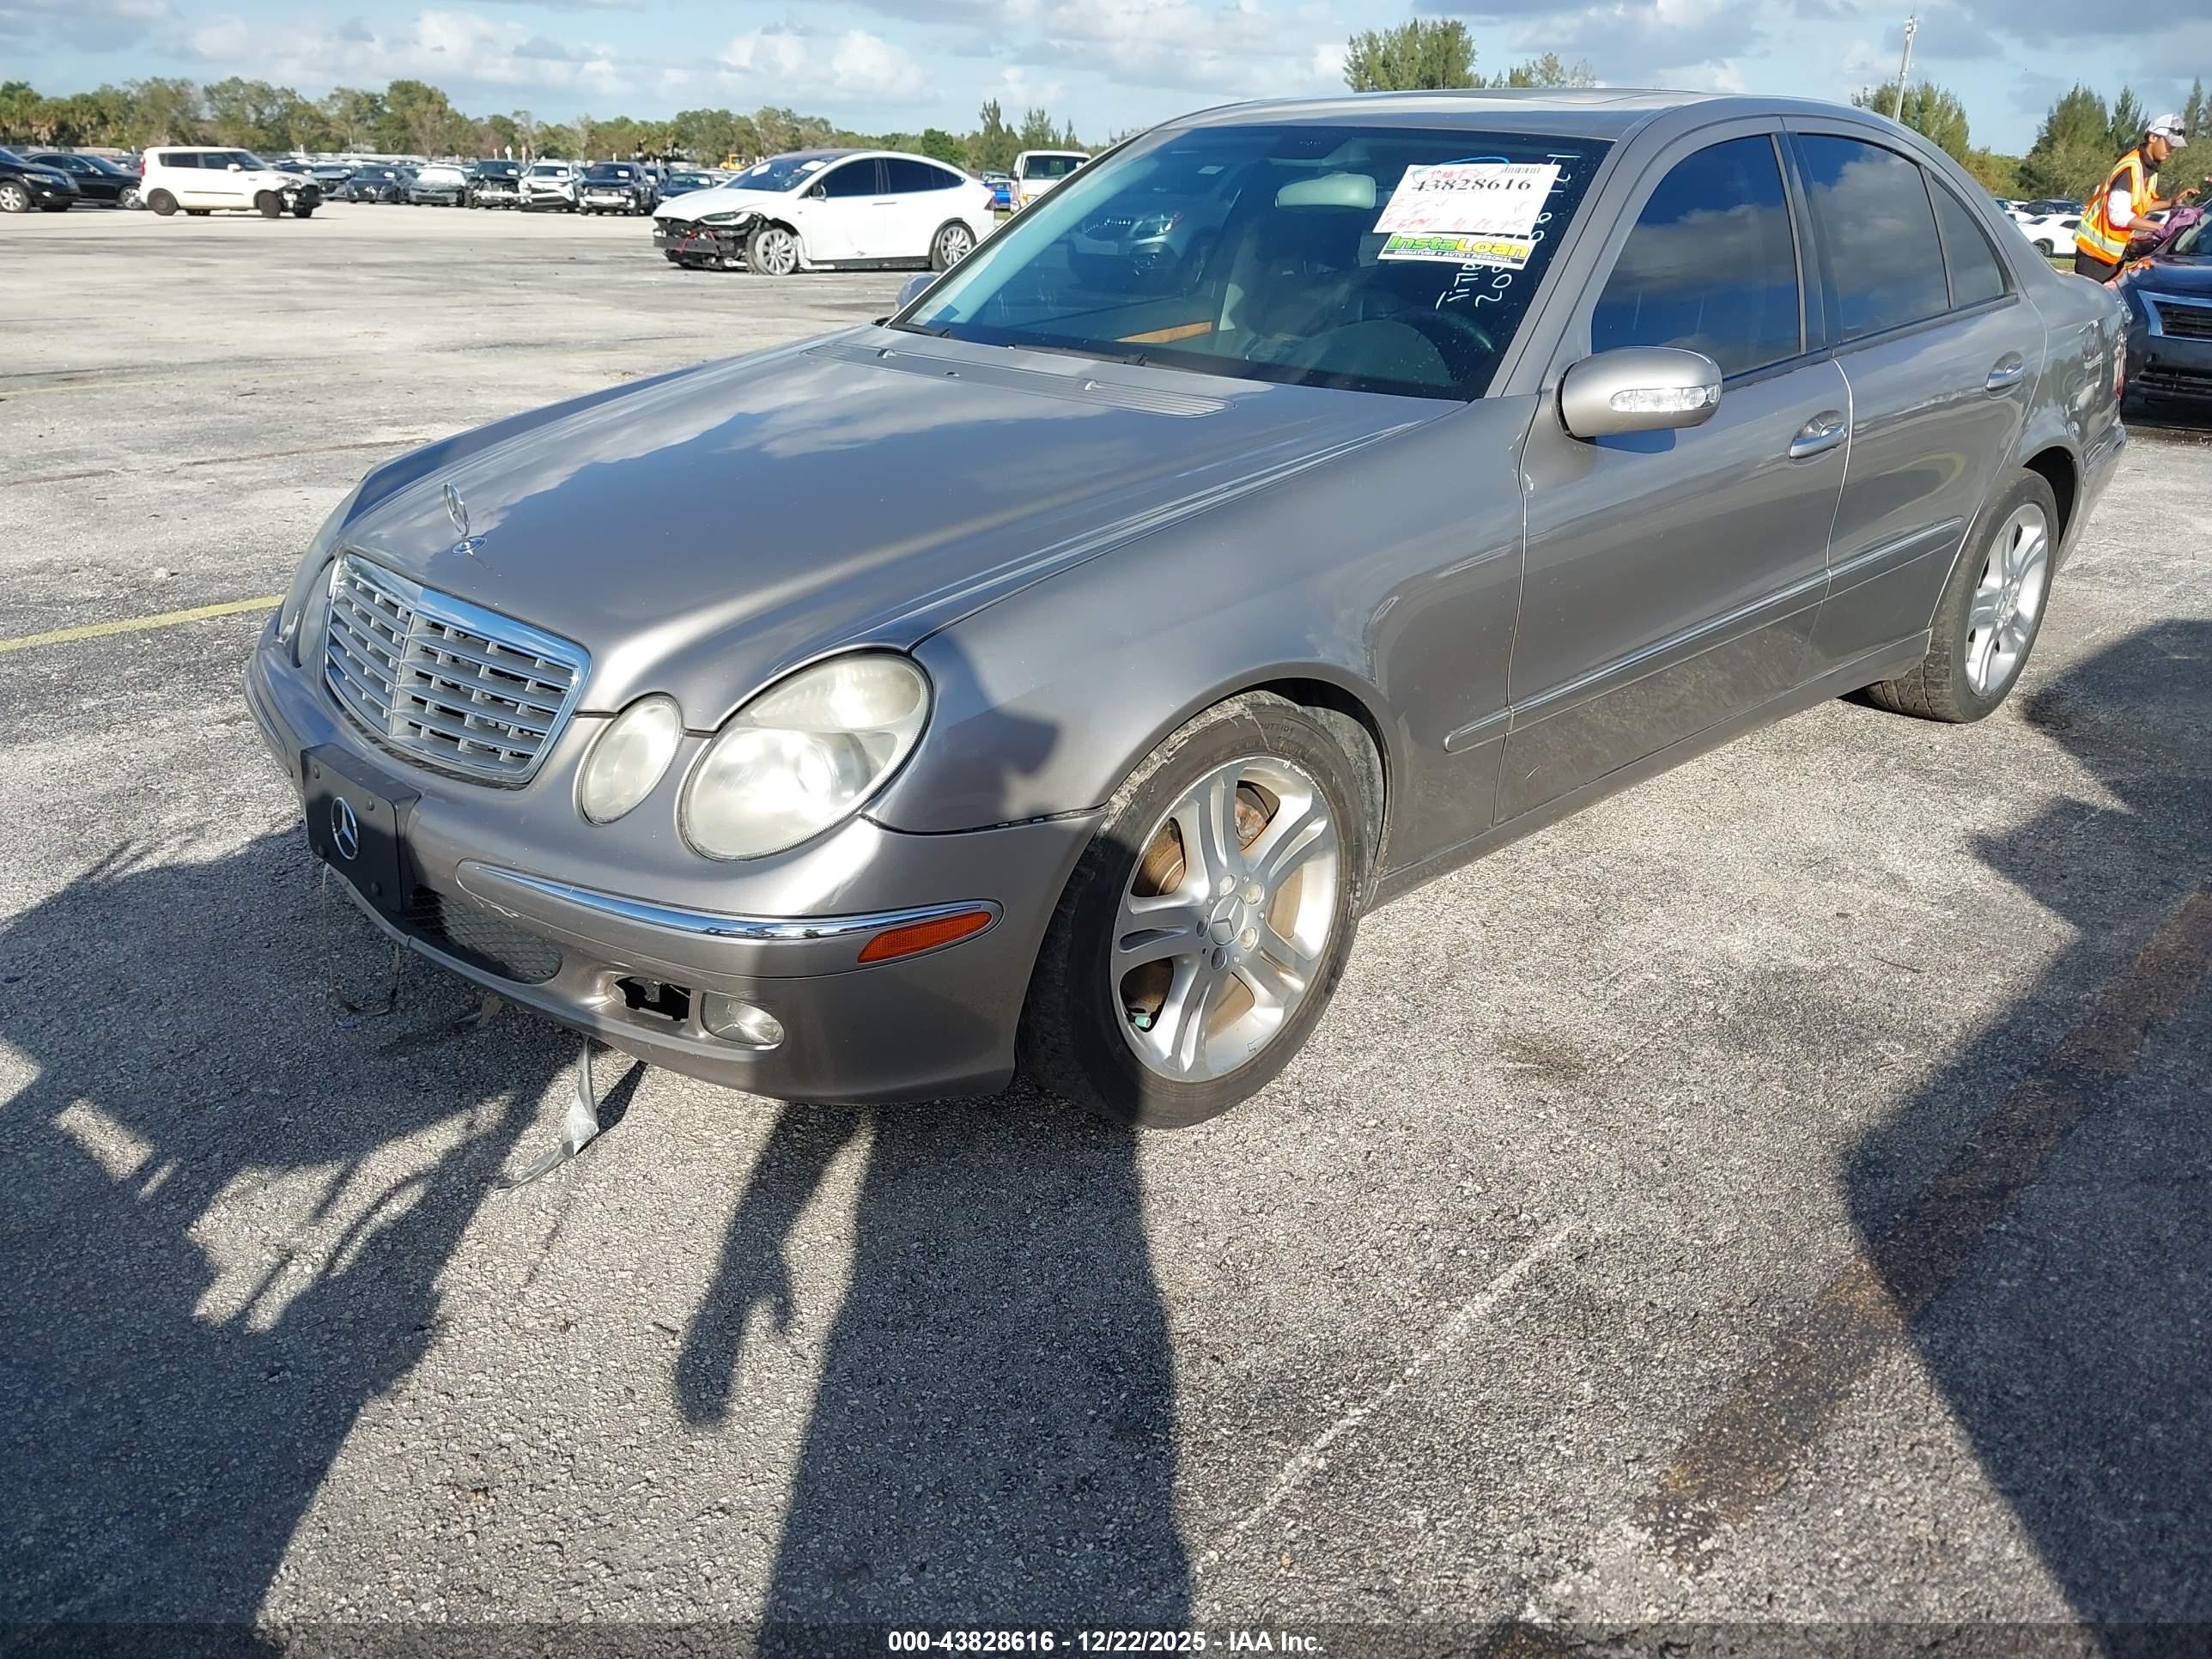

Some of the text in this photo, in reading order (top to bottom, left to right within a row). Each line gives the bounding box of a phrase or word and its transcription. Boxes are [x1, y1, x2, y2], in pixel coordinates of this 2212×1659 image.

[1411, 178, 1532, 191] 43828616
[1387, 235, 1530, 258] InstaLoan
[1471, 254, 1513, 263] PERSONAL
